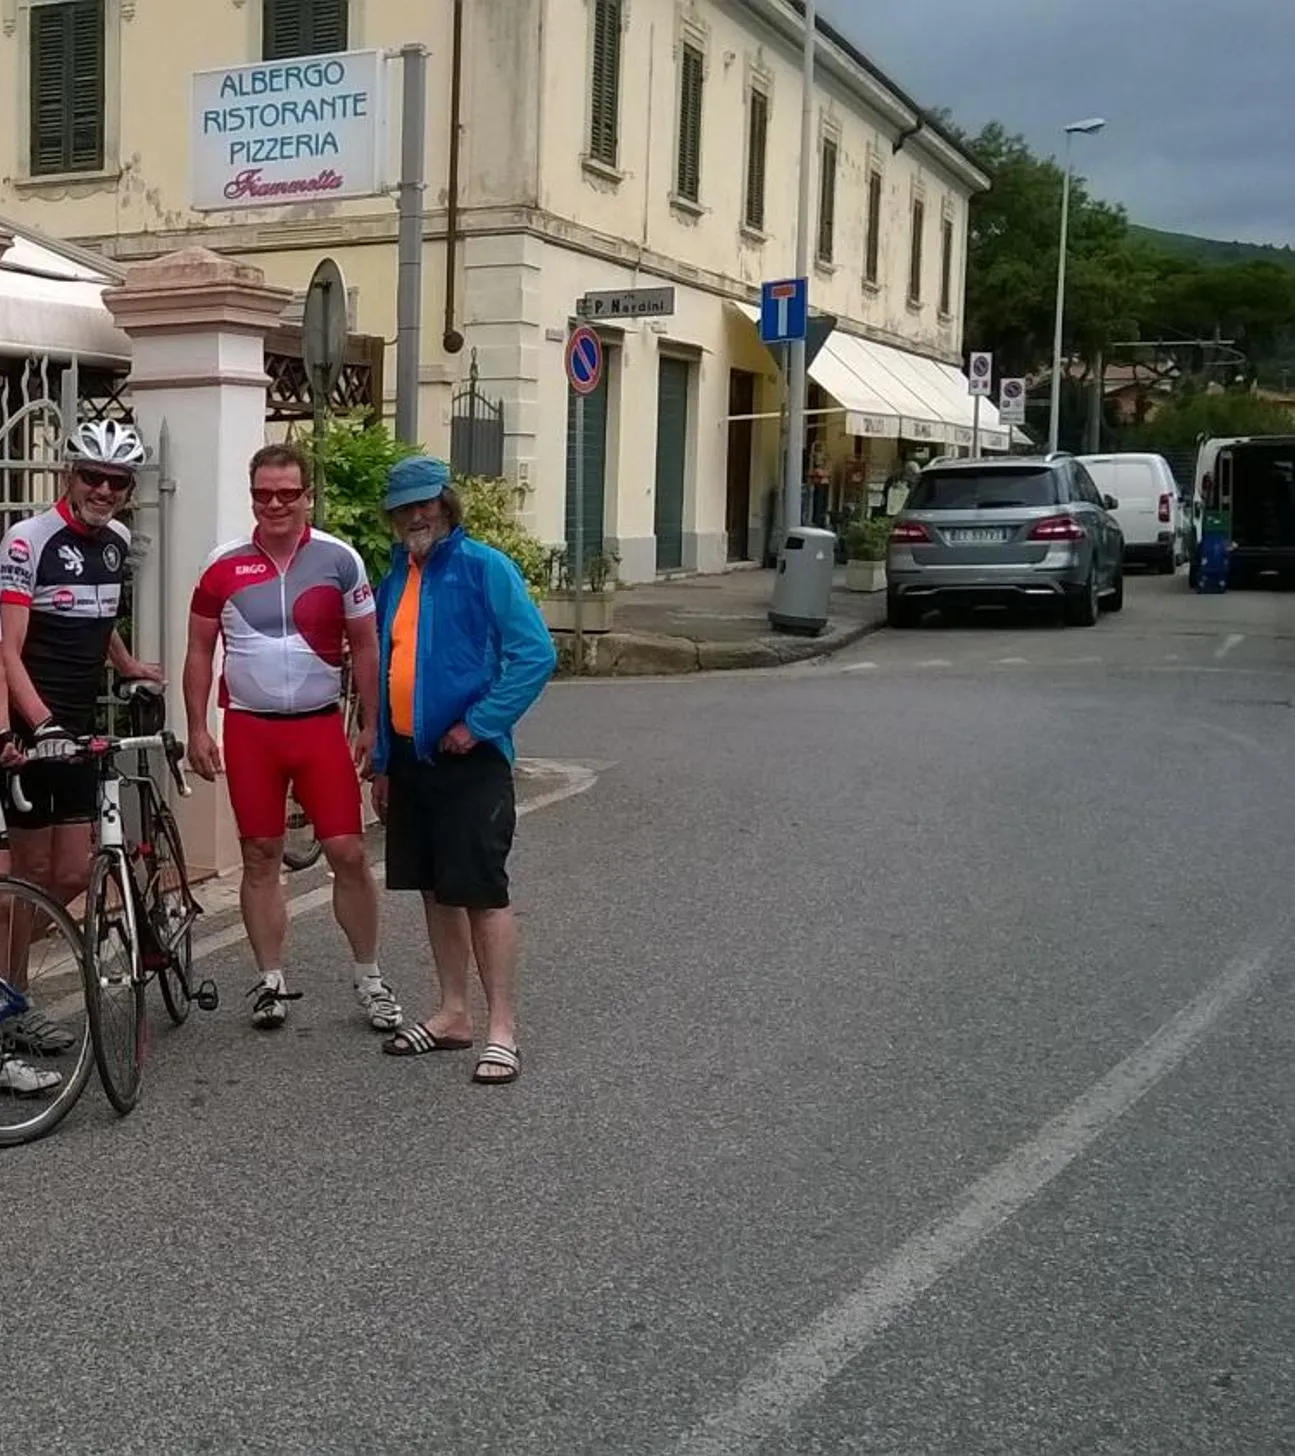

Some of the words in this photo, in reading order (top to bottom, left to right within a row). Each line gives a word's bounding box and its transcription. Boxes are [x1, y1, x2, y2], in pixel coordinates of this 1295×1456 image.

[220, 60, 345, 98] ALBERGO
[204, 92, 367, 134] RISTORANTE
[230, 131, 339, 165] PIZZERIA
[235, 564, 266, 575] ERGO
[352, 583, 372, 605] ER
